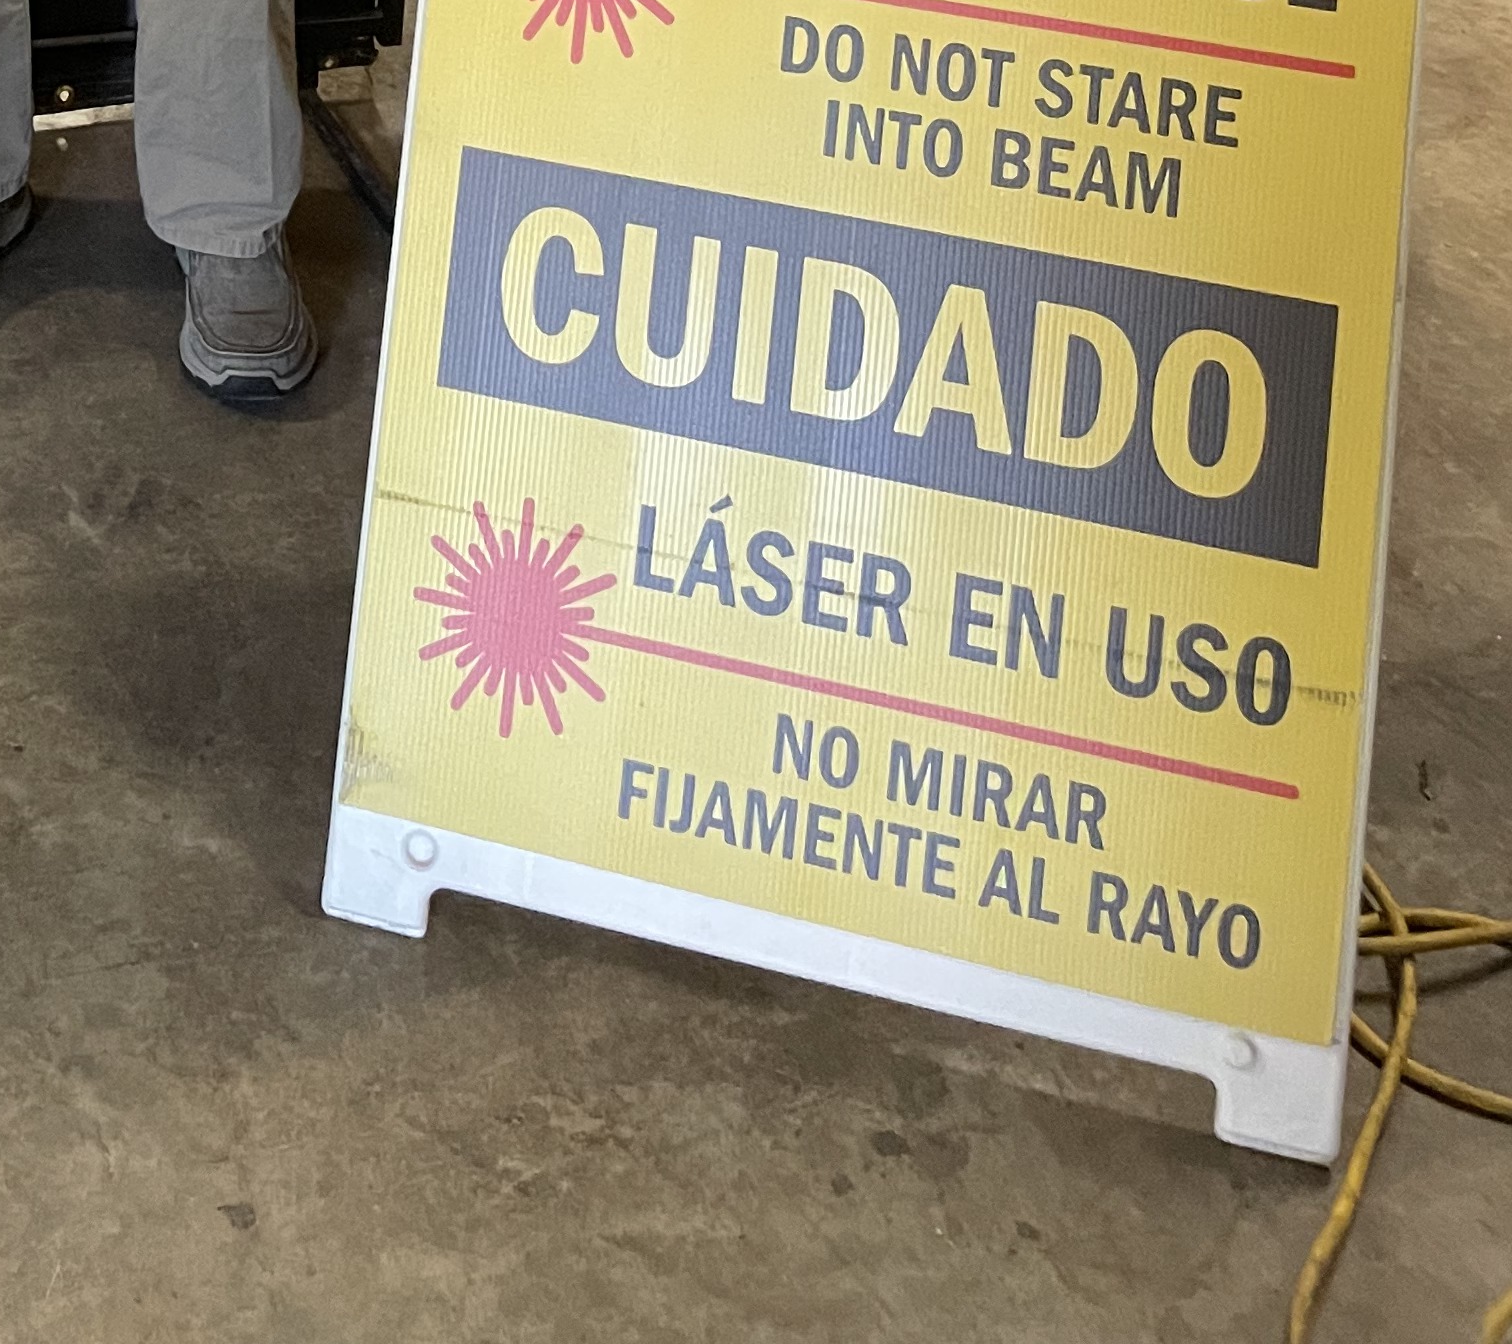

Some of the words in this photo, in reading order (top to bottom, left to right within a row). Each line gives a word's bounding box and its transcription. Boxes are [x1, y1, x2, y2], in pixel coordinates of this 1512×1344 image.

[779, 14, 865, 83] DO
[890, 32, 1015, 109] NOT
[1034, 58, 1243, 149] STARE
[821, 99, 964, 178] INTO
[990, 128, 1182, 219] BEAM
[499, 205, 1268, 500] CUIDADO
[632, 496, 913, 648] LÁSER
[948, 571, 1063, 680] EN
[1103, 605, 1292, 727] USO
[618, 759, 961, 900] FIJAMENTE
[977, 848, 1060, 925] AL
[1086, 871, 1261, 970] RAYO
[771, 713, 860, 789] NO
[888, 738, 1108, 851] MIRAR
